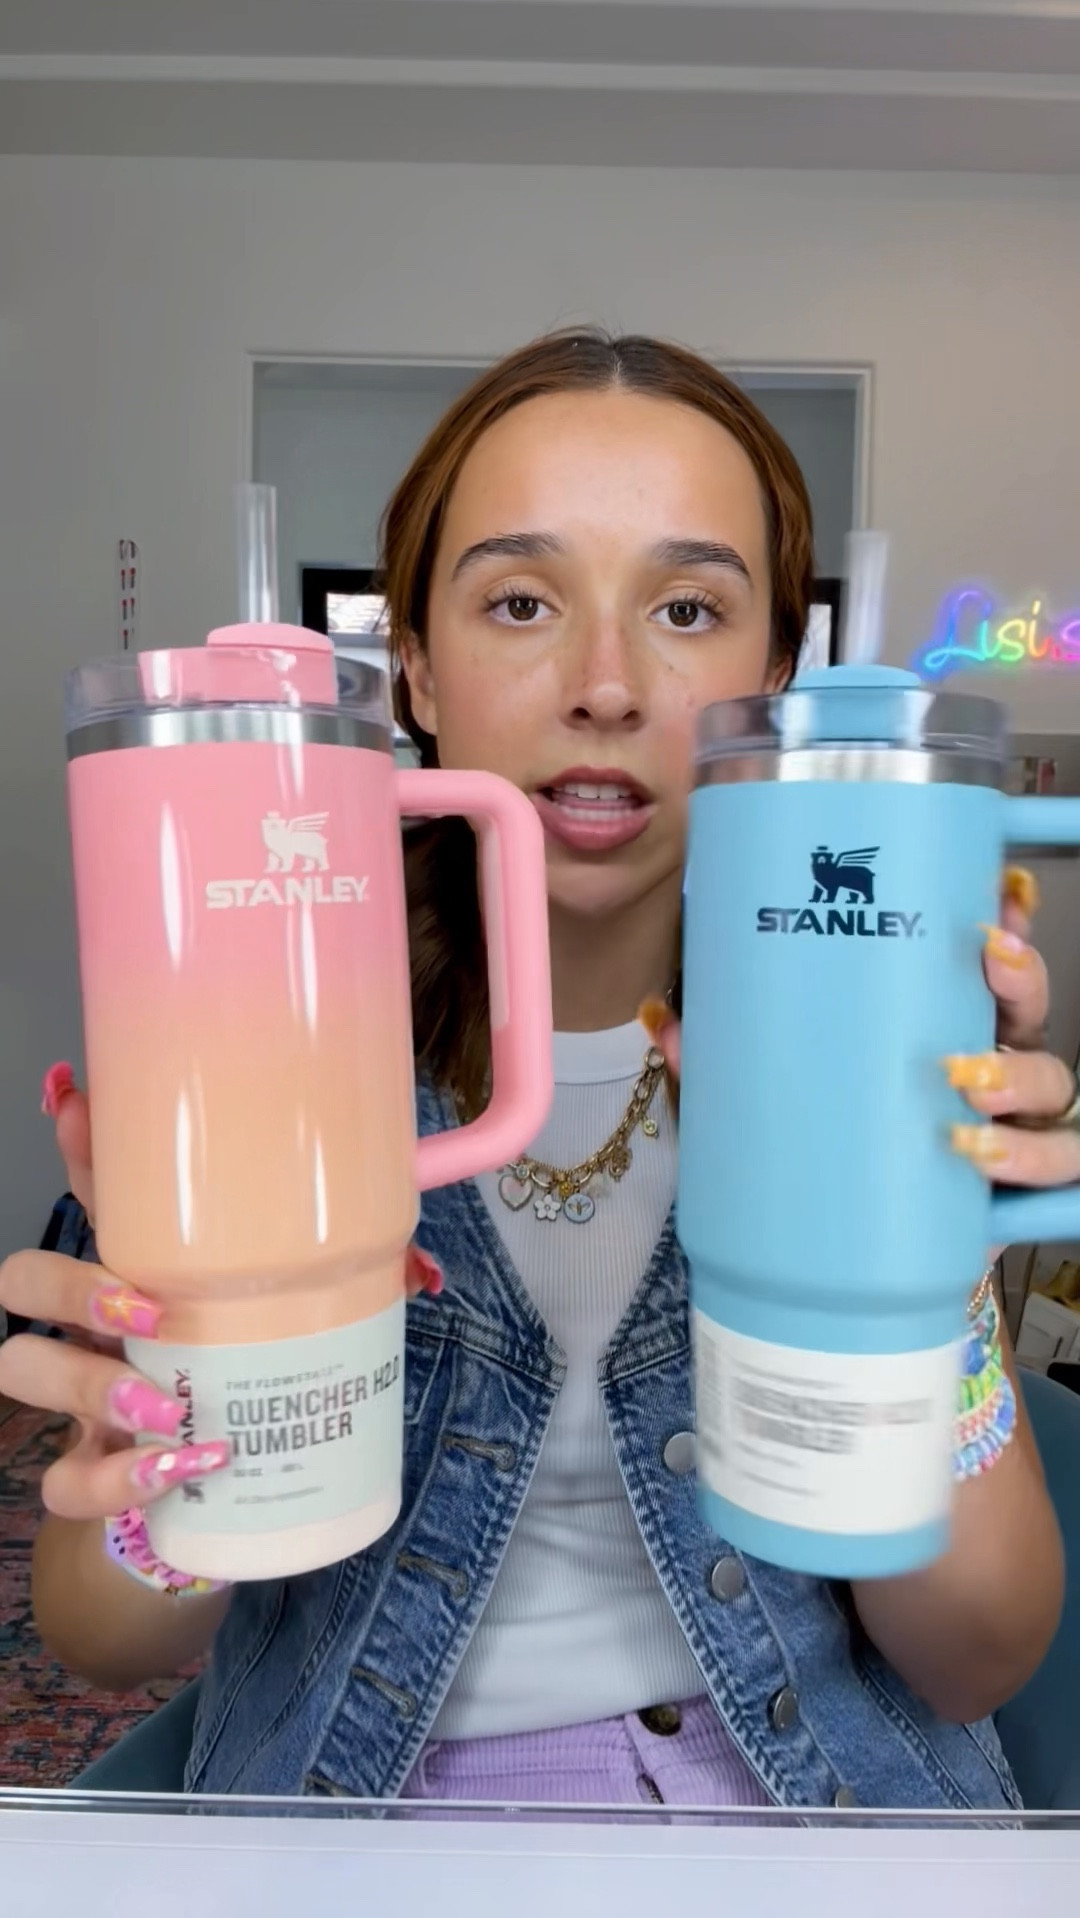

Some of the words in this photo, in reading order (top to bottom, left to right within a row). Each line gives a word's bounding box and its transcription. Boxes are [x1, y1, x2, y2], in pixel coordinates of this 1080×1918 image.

[205, 875, 369, 909] STANLEY
[756, 907, 923, 938] STANLEY
[226, 1380, 251, 1391] THE
[226, 1376, 368, 1427] QUENCHER
[229, 1411, 353, 1457] TUMBLER
